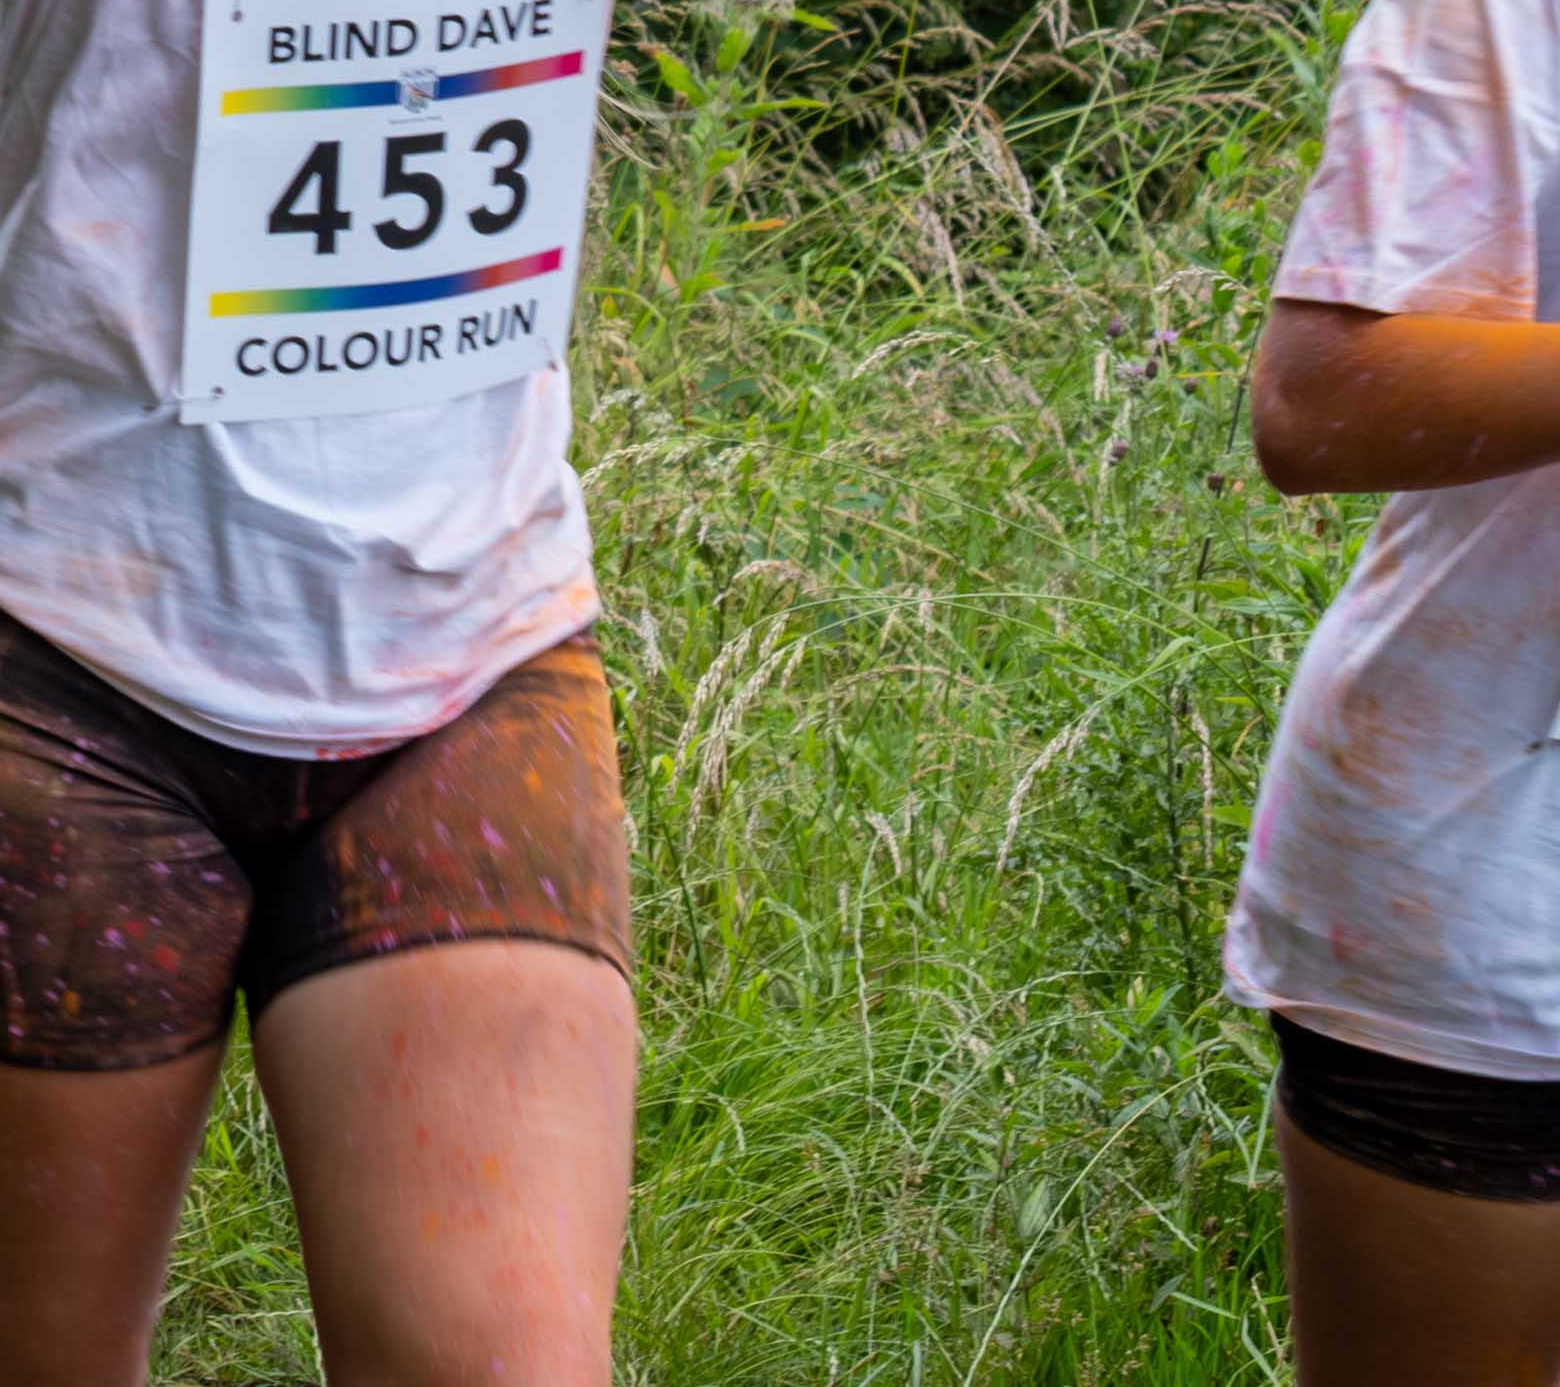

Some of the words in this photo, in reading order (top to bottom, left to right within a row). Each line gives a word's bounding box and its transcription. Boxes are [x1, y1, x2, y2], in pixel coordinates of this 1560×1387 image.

[267, 17, 418, 65] BLIND
[265, 117, 533, 256] 453
[235, 323, 443, 378] COLOUR
[457, 297, 538, 355] RUN
